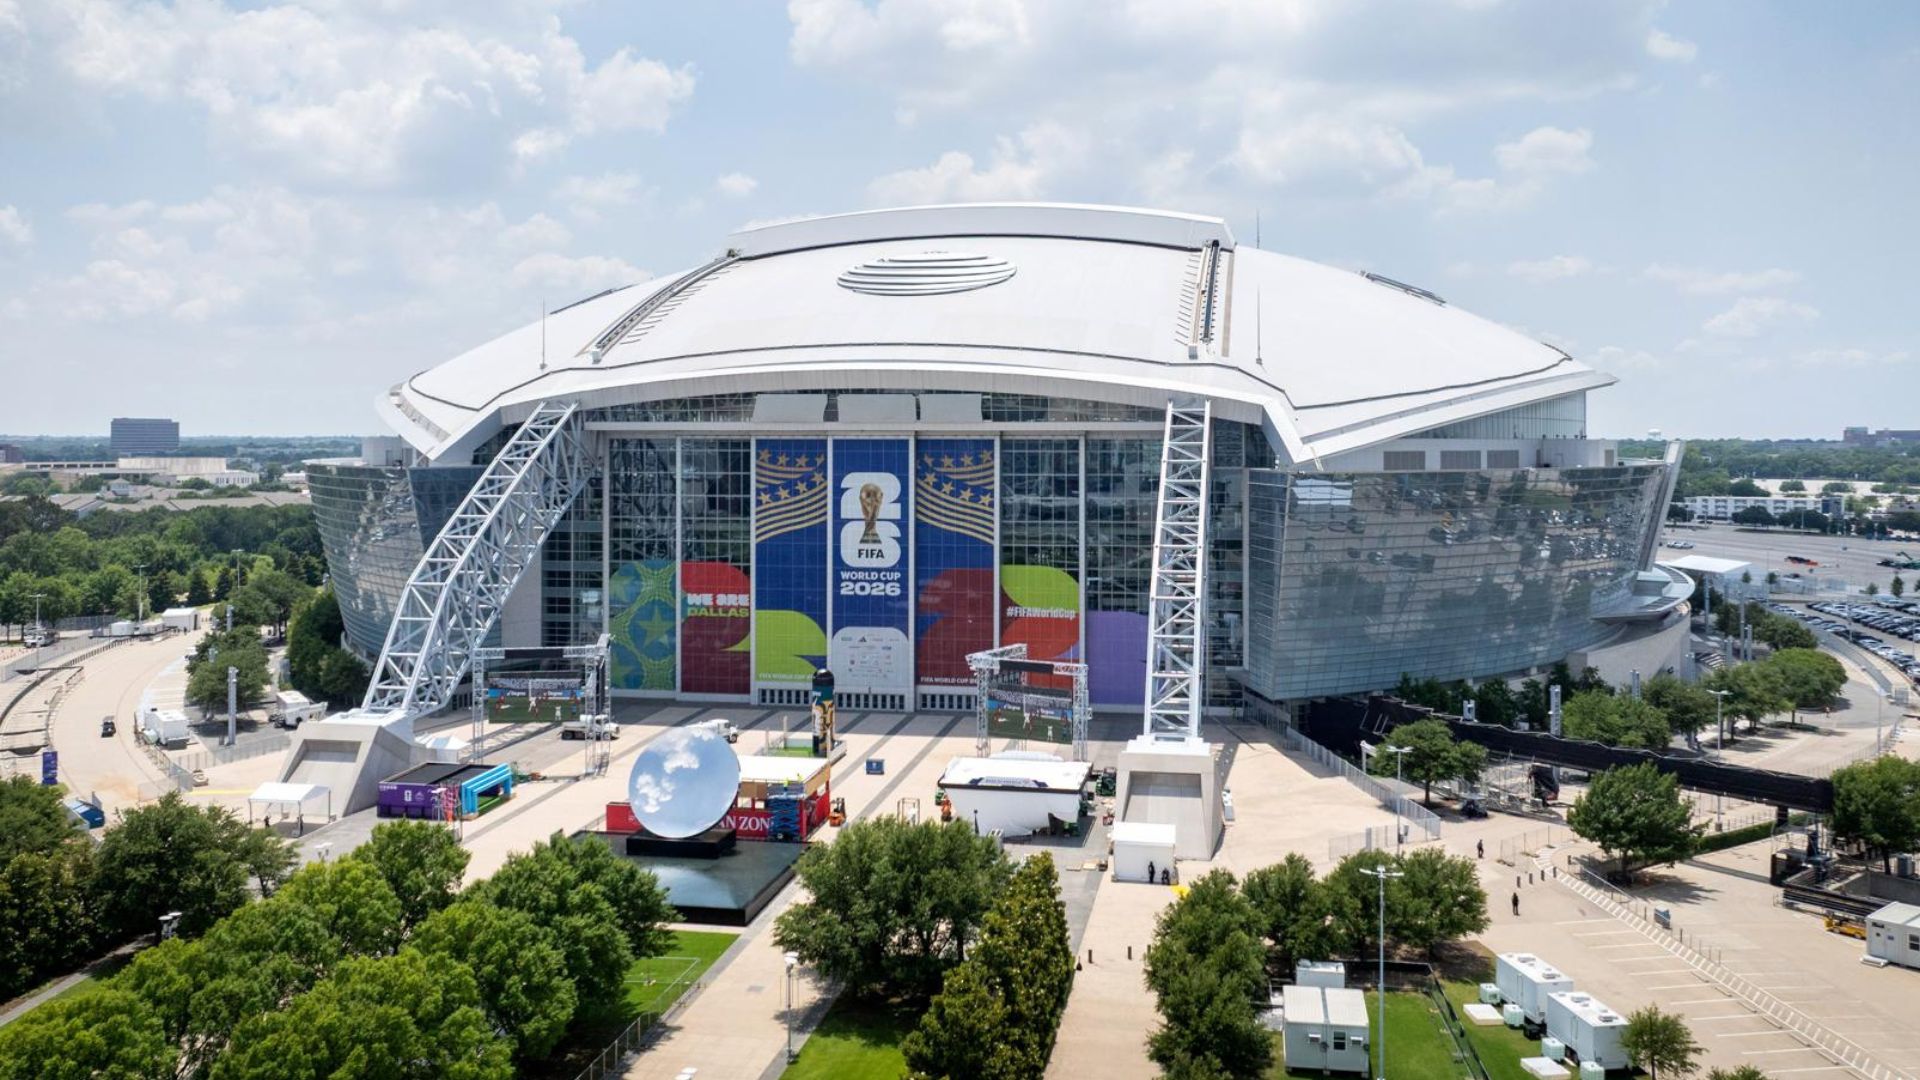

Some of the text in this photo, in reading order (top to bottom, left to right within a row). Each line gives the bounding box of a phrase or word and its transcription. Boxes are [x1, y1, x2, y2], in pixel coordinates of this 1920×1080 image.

[858, 549, 884, 559] FIFA
[841, 571, 901, 580] WORLD CUP
[840, 582, 901, 596] 2026
[687, 607, 749, 617] DALLAS
[1006, 607, 1075, 619] #FIFAWorldCup
[719, 815, 736, 828] AN
